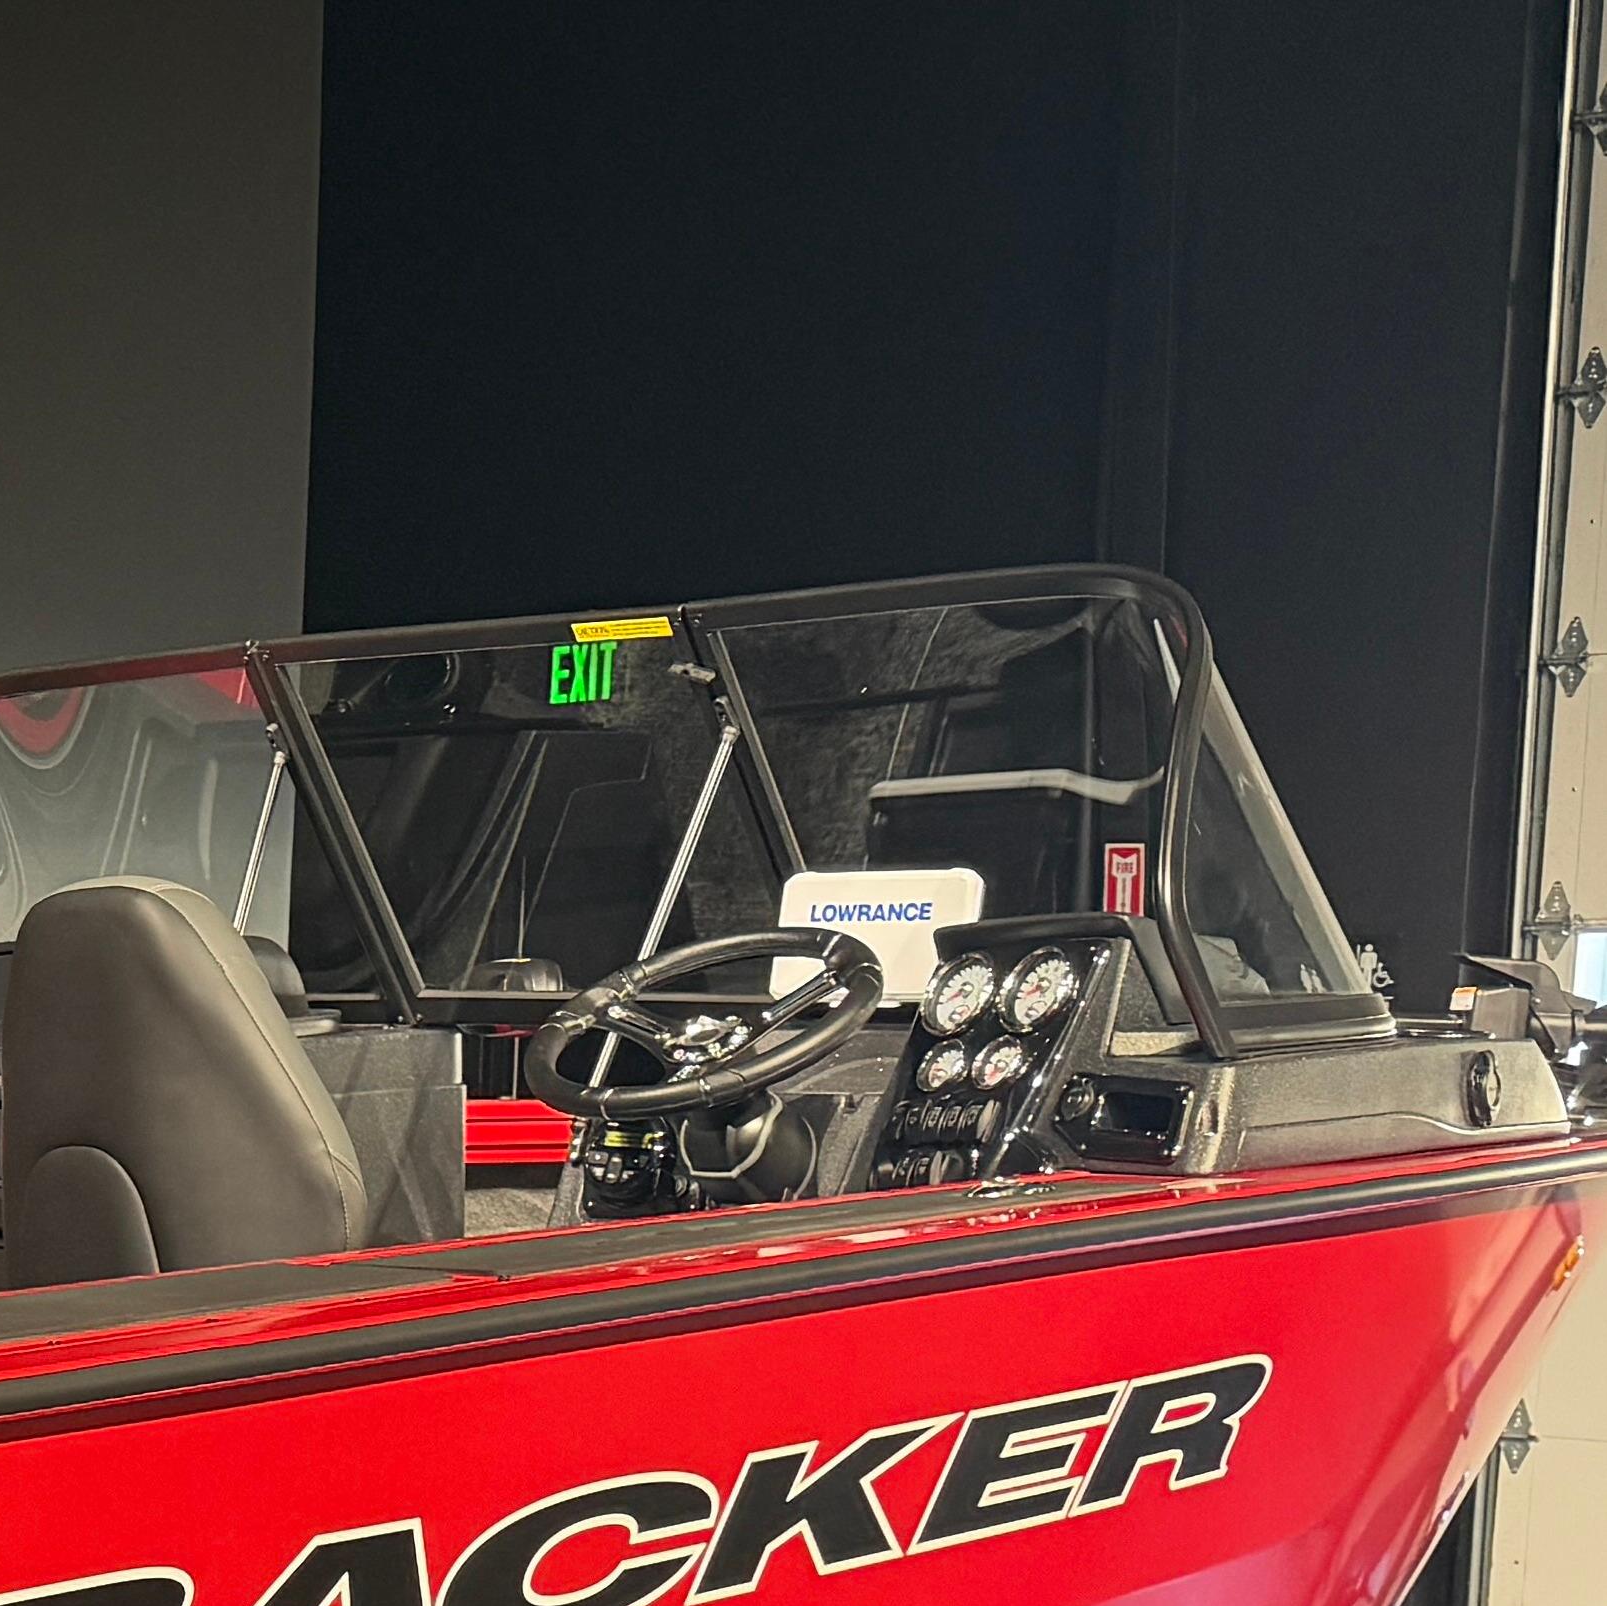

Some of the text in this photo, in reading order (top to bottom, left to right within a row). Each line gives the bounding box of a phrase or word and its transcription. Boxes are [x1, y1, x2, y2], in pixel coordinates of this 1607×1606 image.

[550, 641, 617, 704] EXIT
[1116, 861, 1134, 874] FIRE
[810, 902, 932, 922] LOWRANCE
